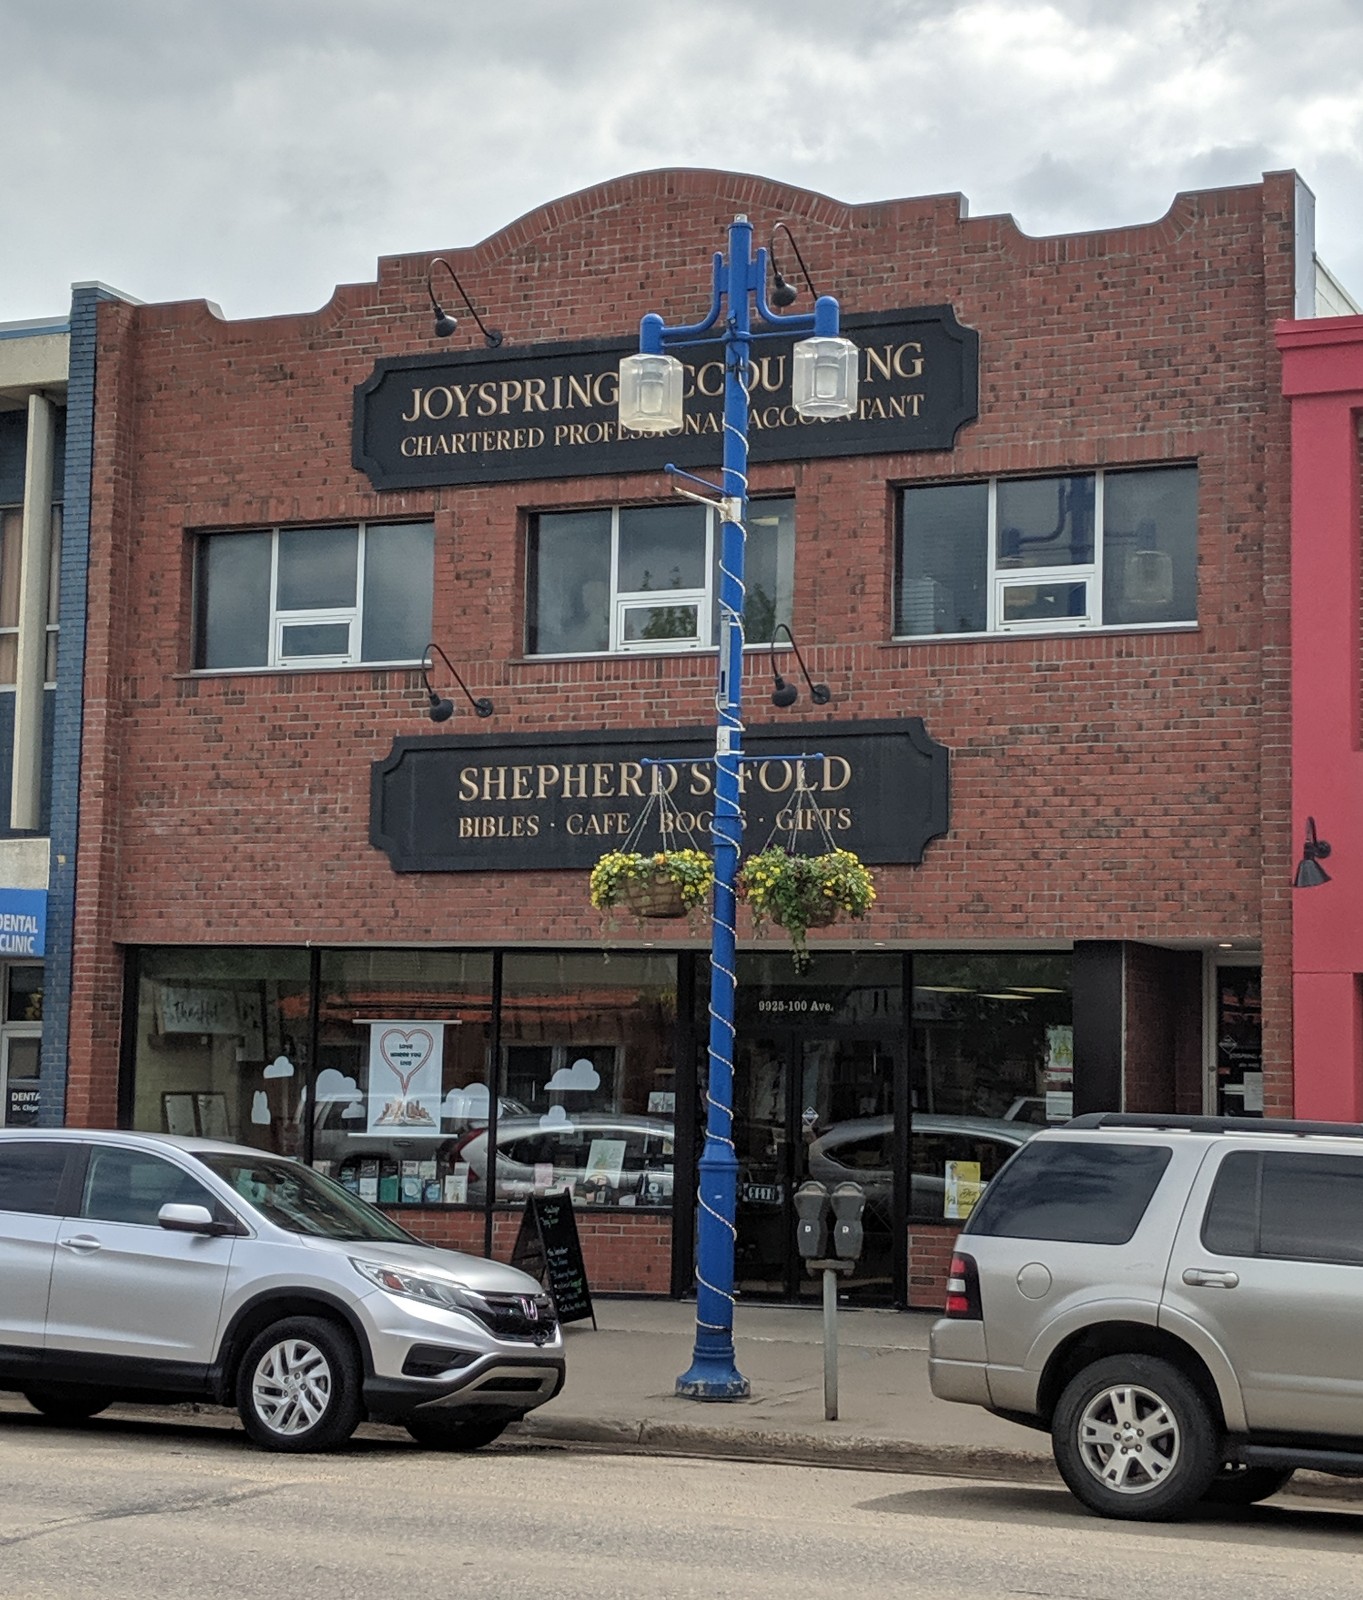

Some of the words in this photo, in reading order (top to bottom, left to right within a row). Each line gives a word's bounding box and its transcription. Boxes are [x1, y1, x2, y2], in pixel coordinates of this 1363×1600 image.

[402, 371, 619, 422] JOYSPRING
[400, 428, 545, 457] CHARTERED
[554, 411, 726, 447] PROFENA
[747, 393, 925, 430] ACCTANT
[738, 756, 852, 794] FOLD
[458, 814, 540, 838] BIBLES
[566, 812, 632, 836] CAFE
[658, 810, 748, 834] BOO
[775, 807, 852, 831] GIFTS
[0, 933, 35, 954] CLINIC
[810, 1000, 834, 1012] Ave.
